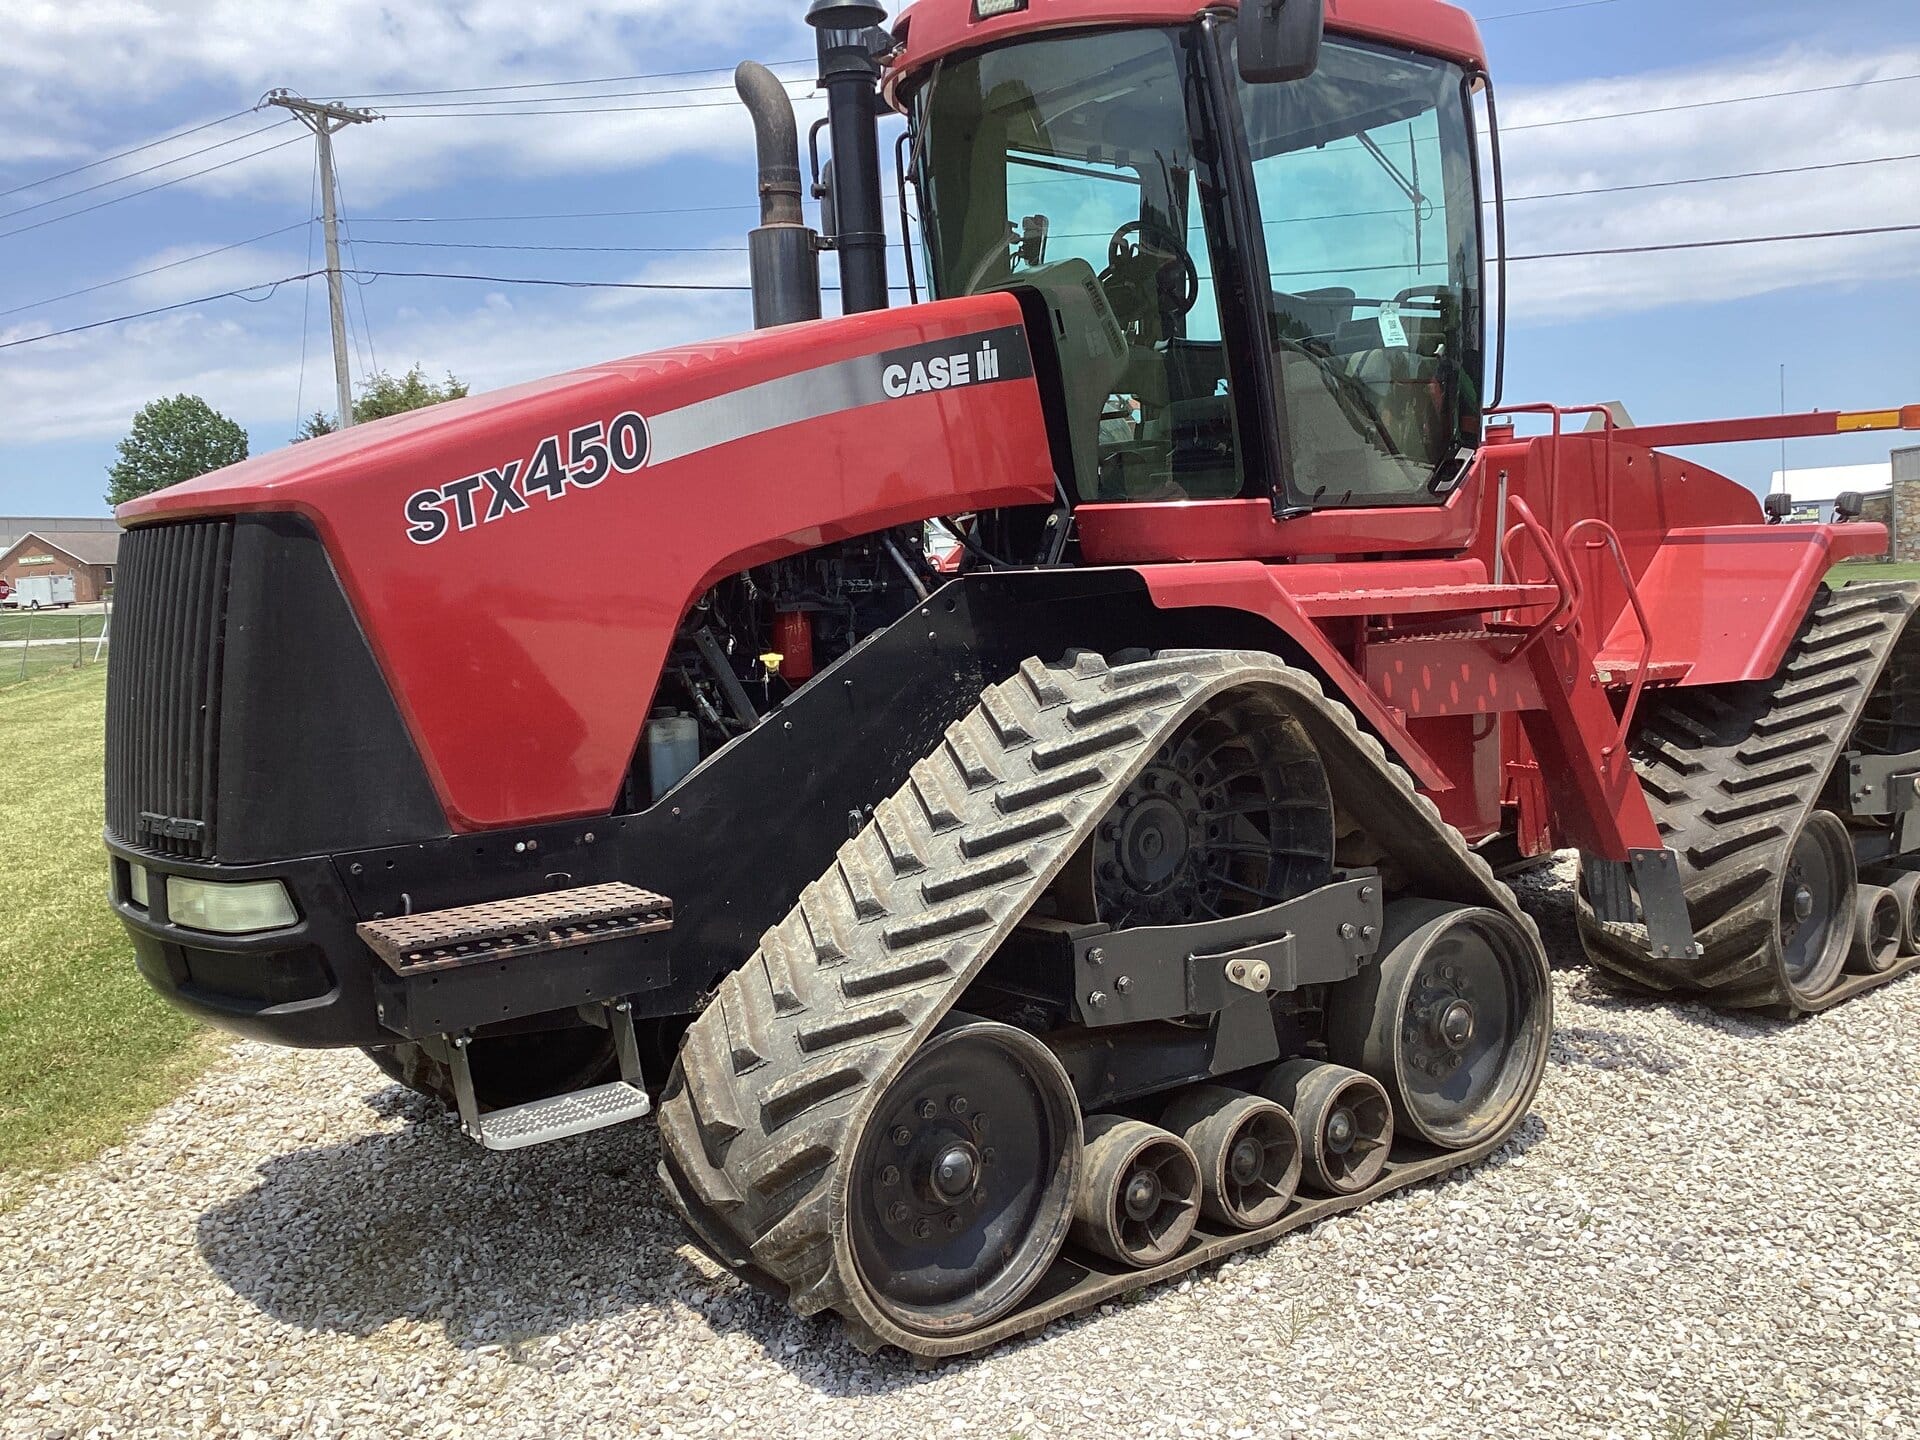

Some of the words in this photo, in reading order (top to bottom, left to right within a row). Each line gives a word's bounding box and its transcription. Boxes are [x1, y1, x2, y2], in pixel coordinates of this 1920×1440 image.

[882, 353, 970, 398] CASE
[404, 411, 651, 545] STX450
[0, 586, 9, 594] OP
